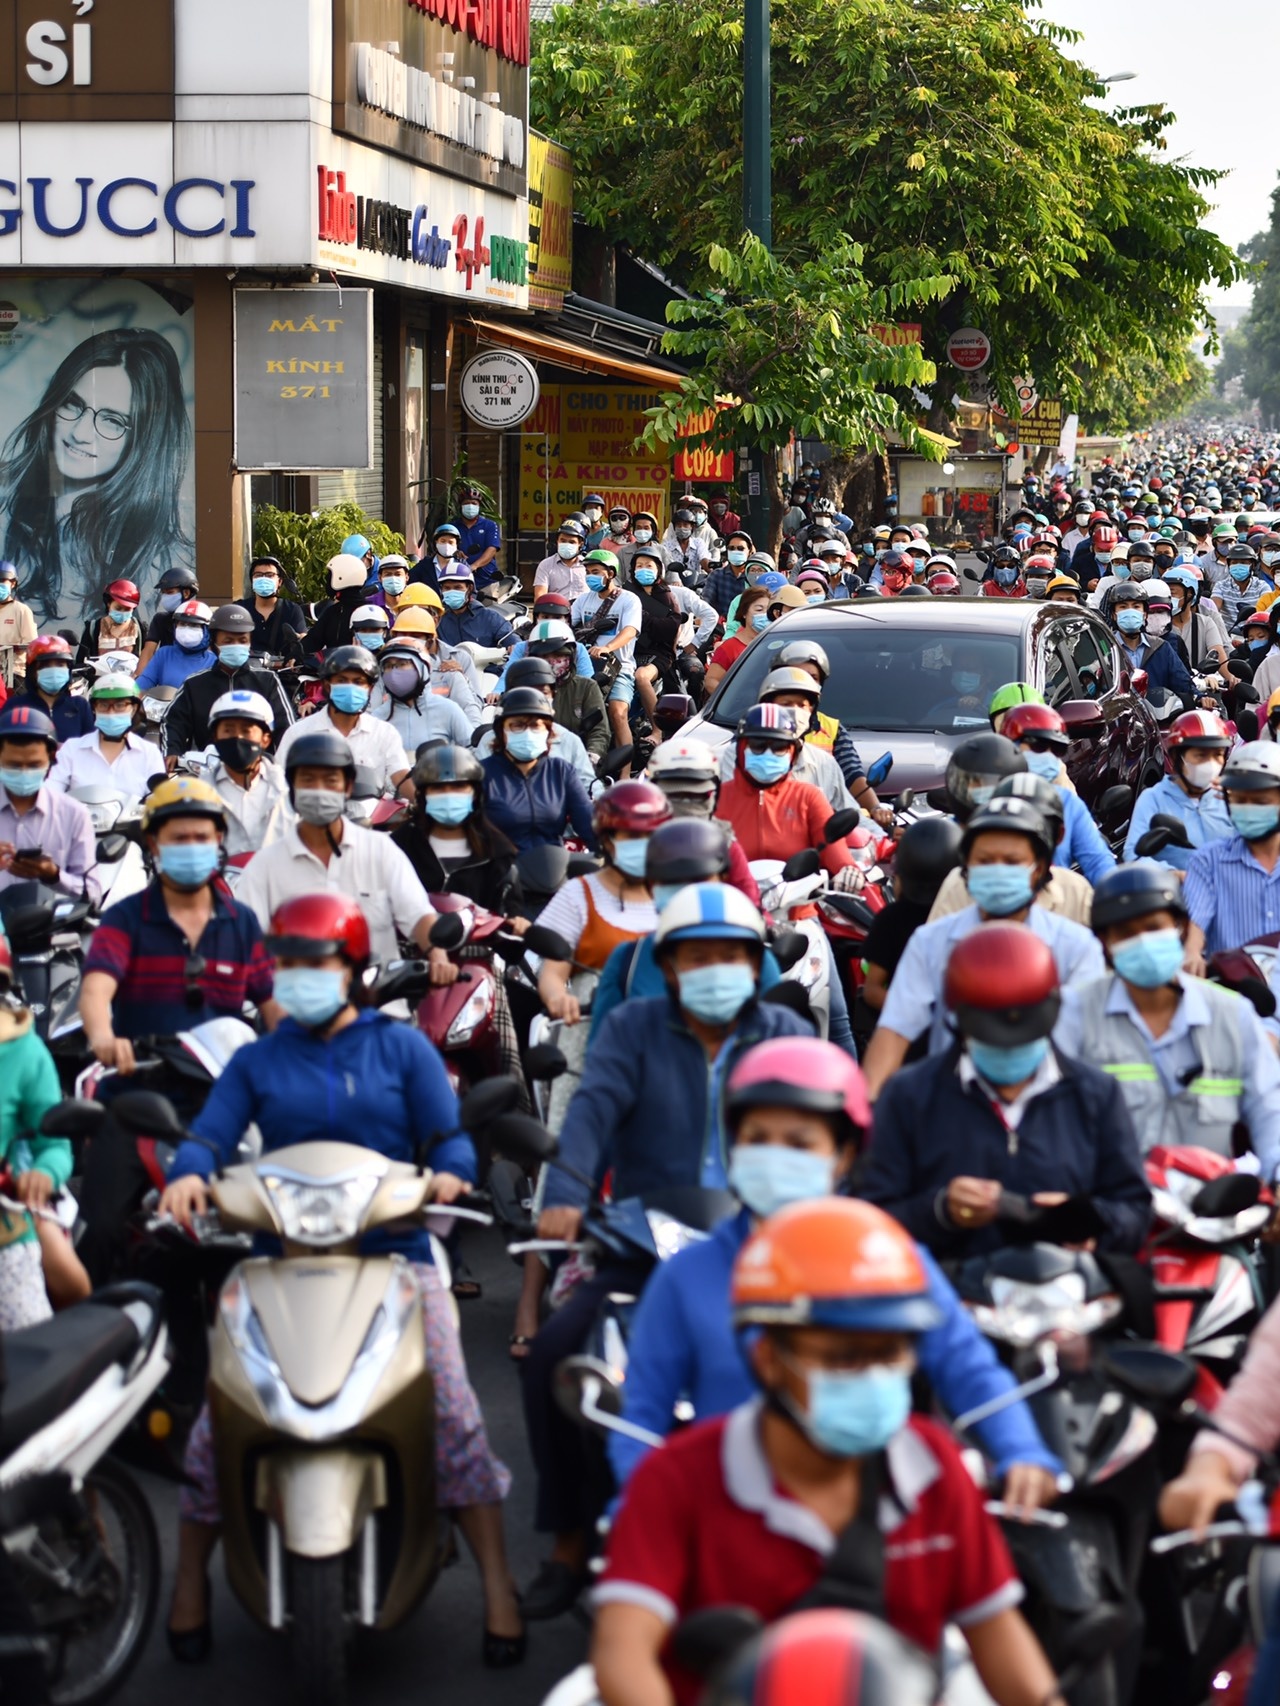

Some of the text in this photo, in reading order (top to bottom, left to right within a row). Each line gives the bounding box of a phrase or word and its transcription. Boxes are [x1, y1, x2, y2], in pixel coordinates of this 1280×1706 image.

[357, 195, 413, 261] LACOSTE
[265, 358, 345, 375] KÍNH
[472, 373, 490, 383] KÍNH
[280, 385, 331, 399] 371
[485, 397, 511, 405] 371 NK
[566, 392, 609, 410] CHO
[591, 417, 624, 434] PHOTO
[682, 446, 725, 477] COPY
[577, 465, 628, 481] KHO
[635, 464, 667, 485] TỘ
[587, 491, 662, 519] OTOCOPY
